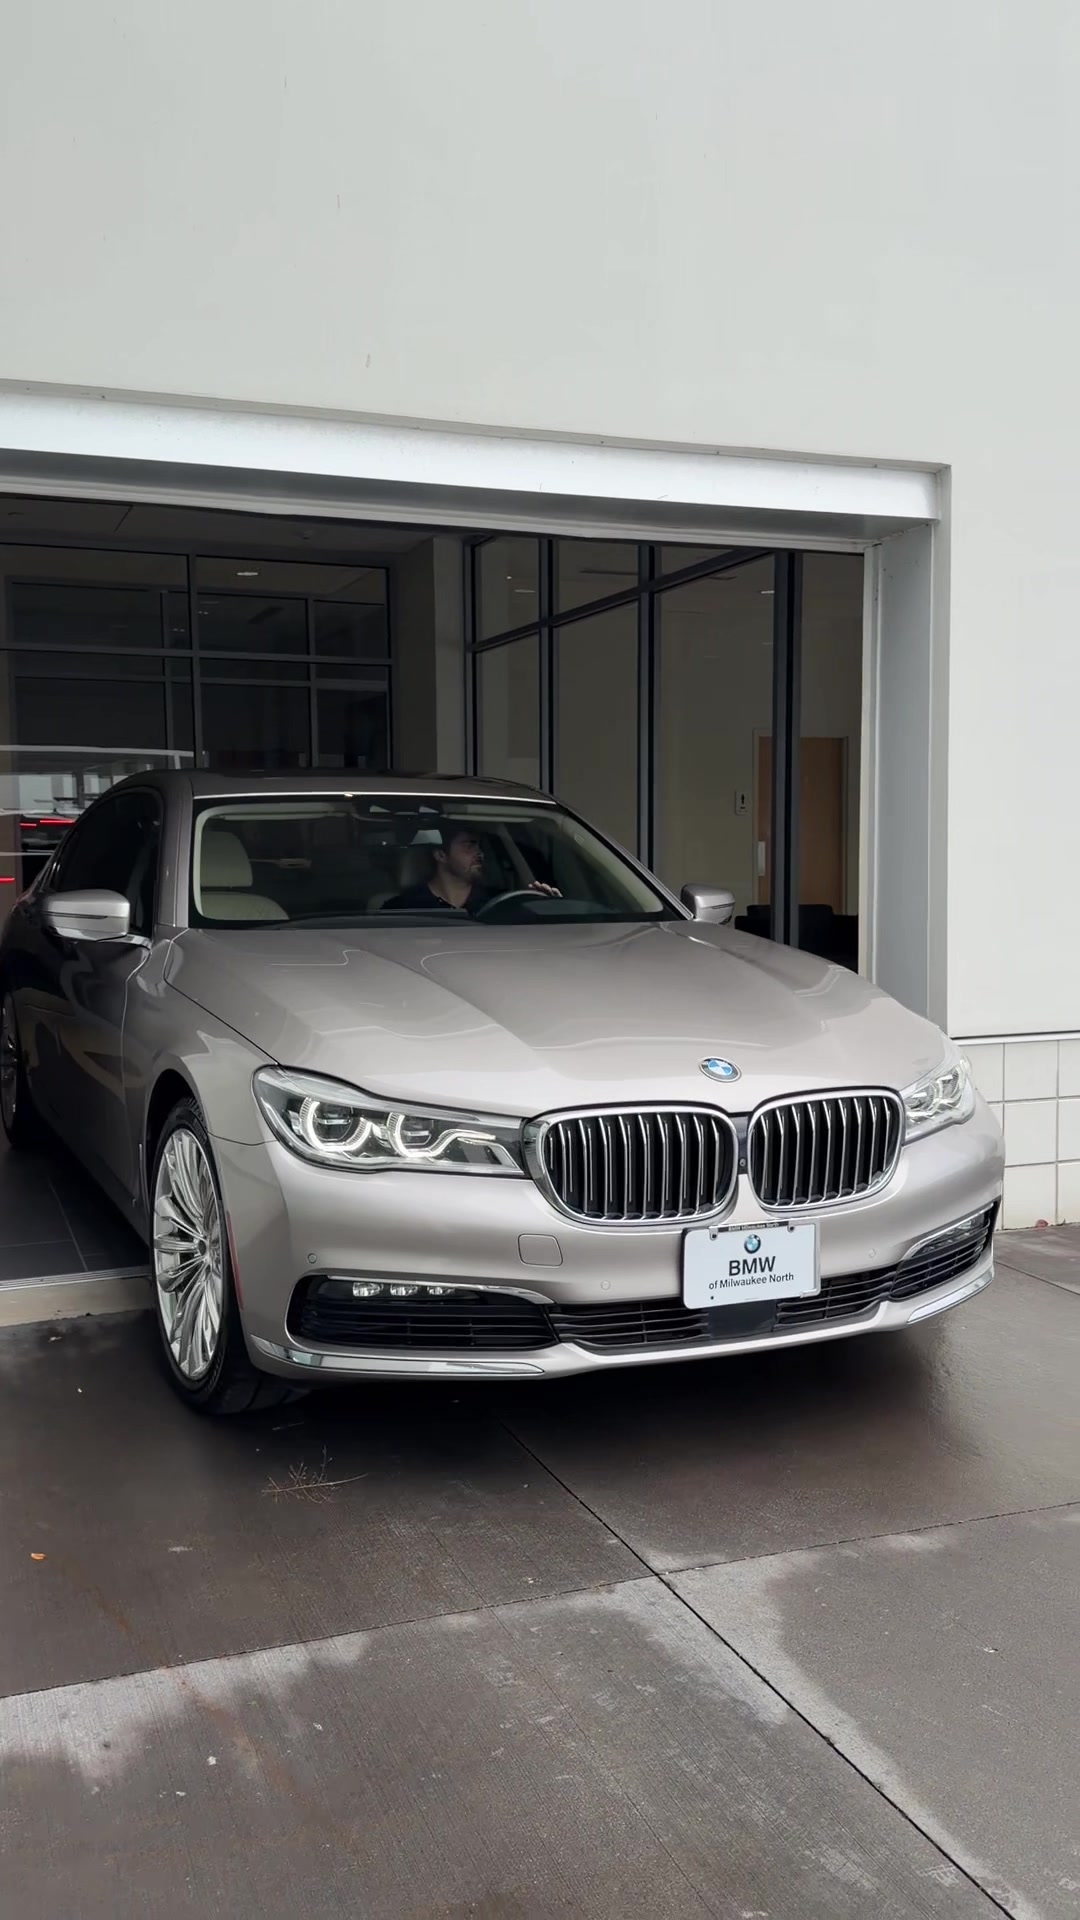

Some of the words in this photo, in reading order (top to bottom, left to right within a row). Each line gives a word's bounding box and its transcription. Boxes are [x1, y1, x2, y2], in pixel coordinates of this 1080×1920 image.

[728, 1256, 776, 1276] BMW
[708, 1280, 719, 1290] of
[720, 1276, 767, 1288] Milwaukee
[769, 1272, 794, 1283] North
